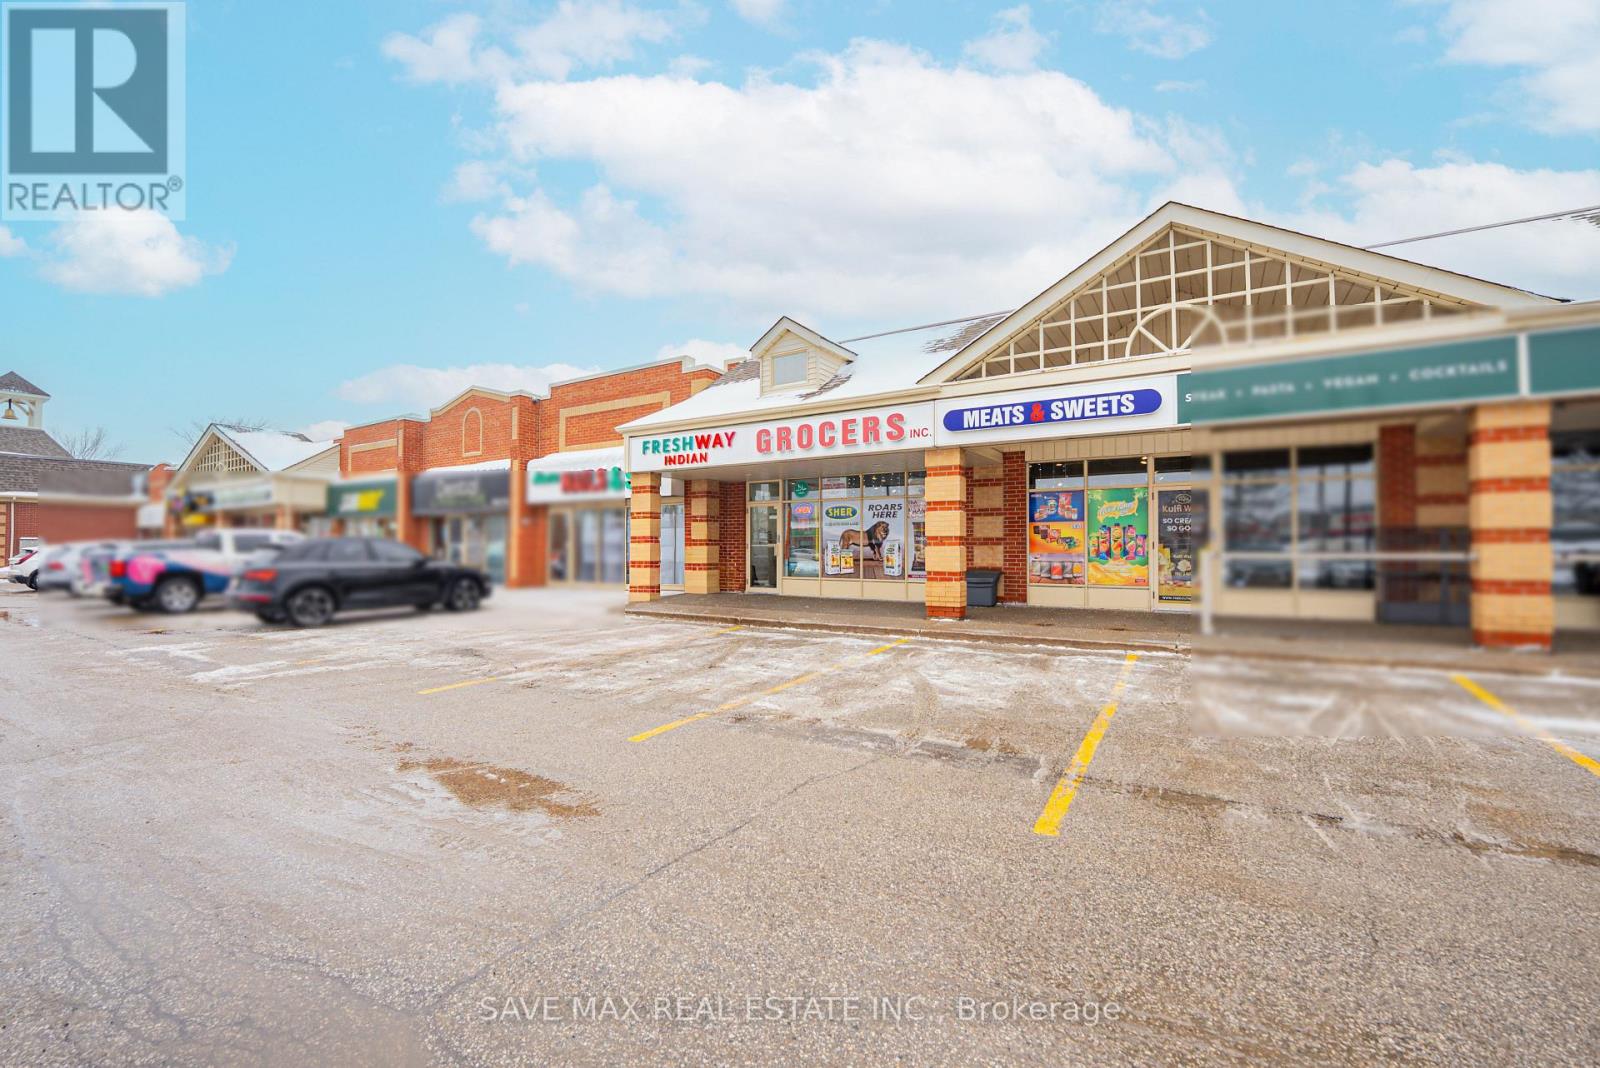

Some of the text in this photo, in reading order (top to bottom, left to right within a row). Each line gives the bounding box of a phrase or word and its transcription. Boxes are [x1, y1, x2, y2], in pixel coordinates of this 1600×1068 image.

[963, 393, 1135, 429] MEATS & SWEETS
[756, 412, 932, 454] GROCERS INC.
[642, 431, 736, 455] FRESHWAY
[664, 452, 709, 466] INDIAN
[828, 507, 853, 517] SHER
[868, 503, 903, 512] ROARS
[872, 511, 898, 519] HERE
